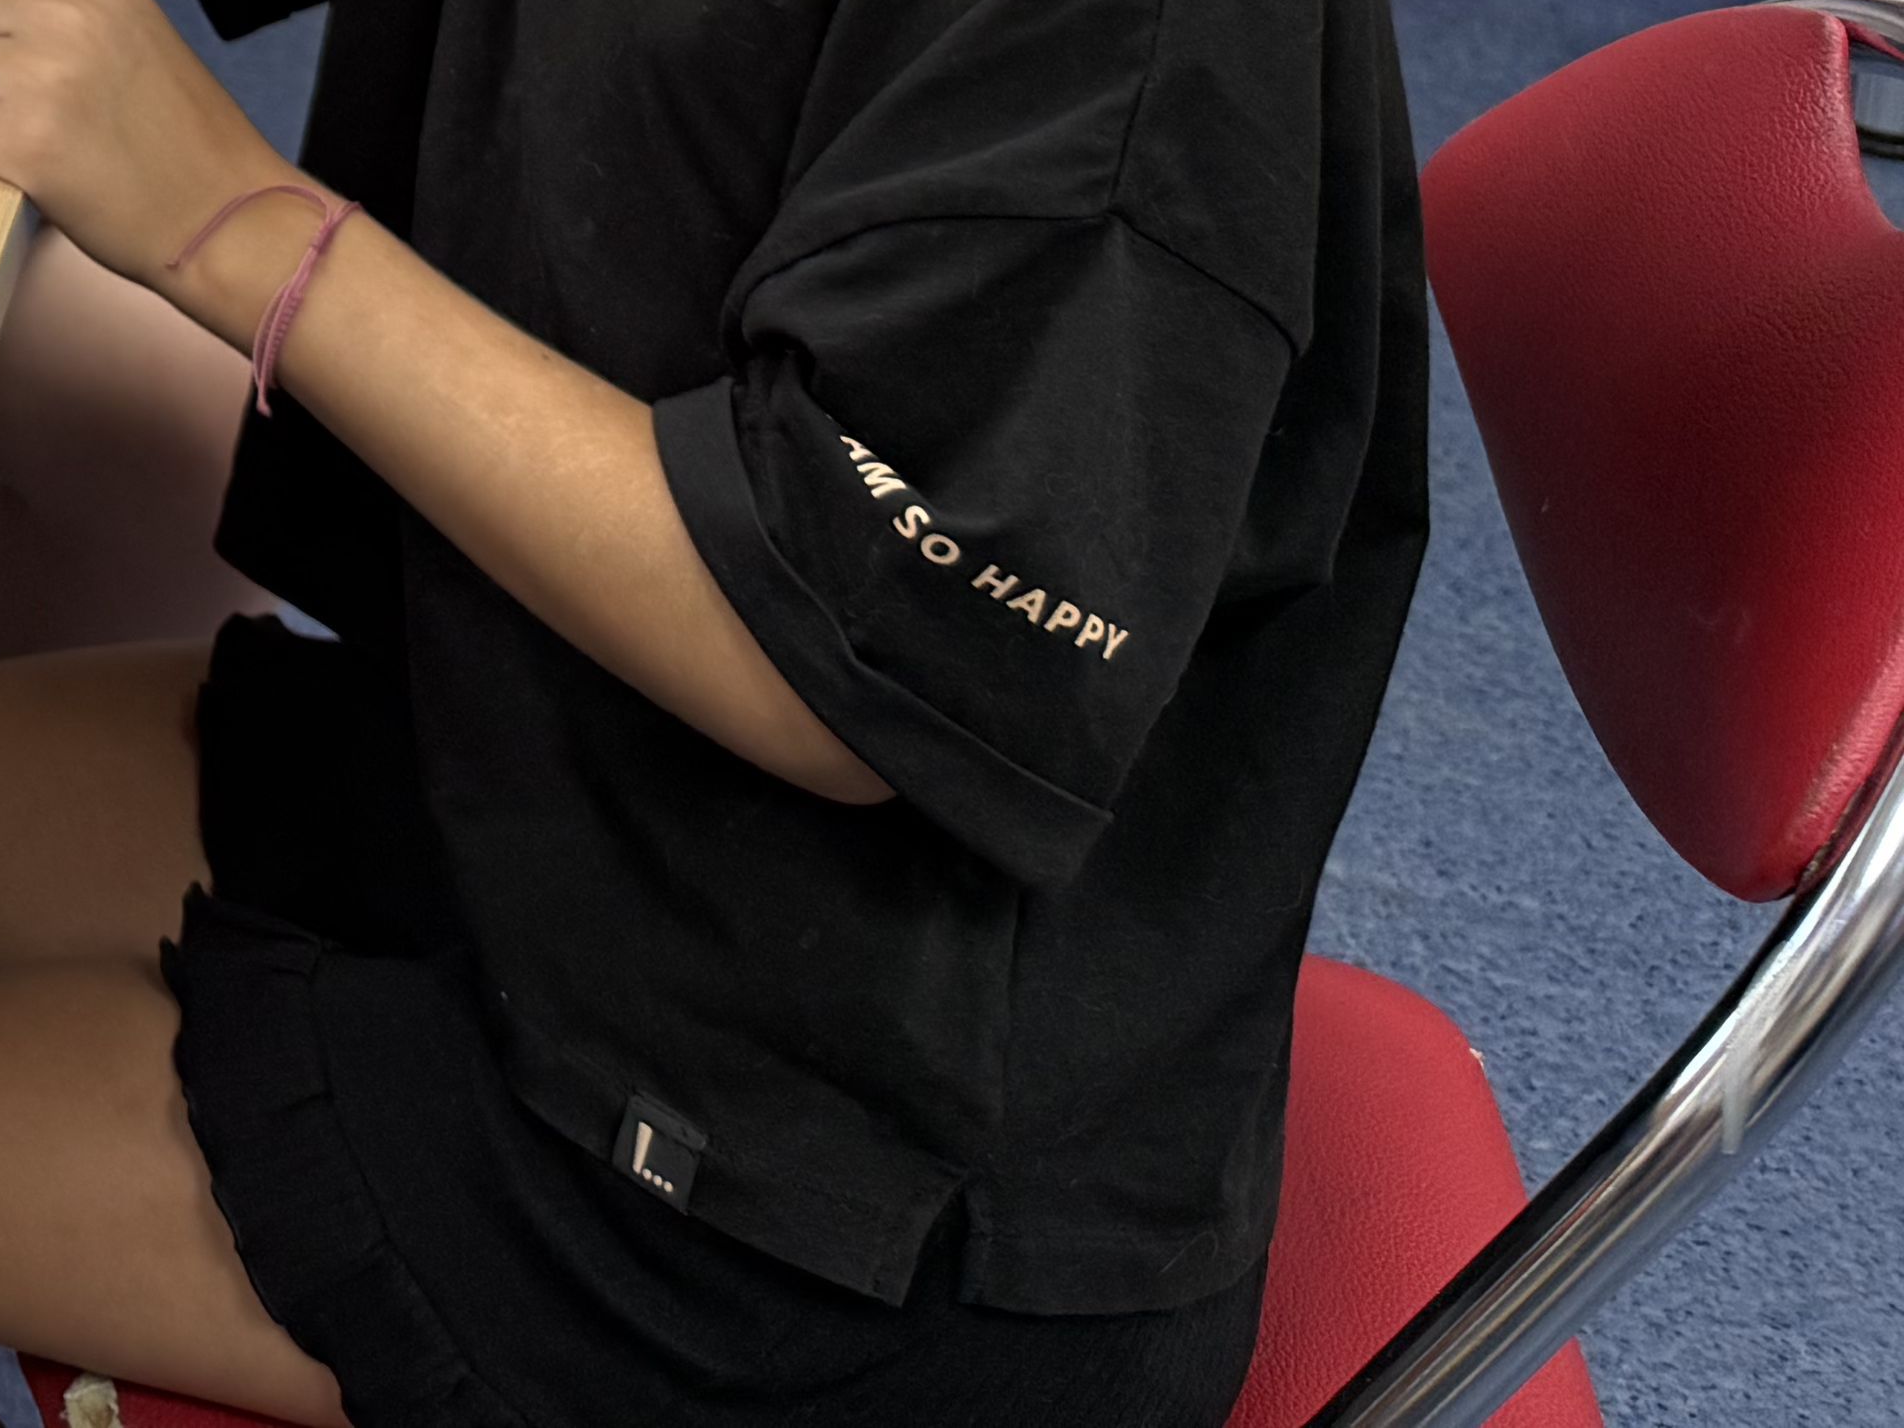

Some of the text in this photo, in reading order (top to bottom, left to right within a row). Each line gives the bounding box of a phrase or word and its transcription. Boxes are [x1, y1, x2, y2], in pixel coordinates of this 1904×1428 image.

[840, 435, 1129, 660] AM SO HAPPY
